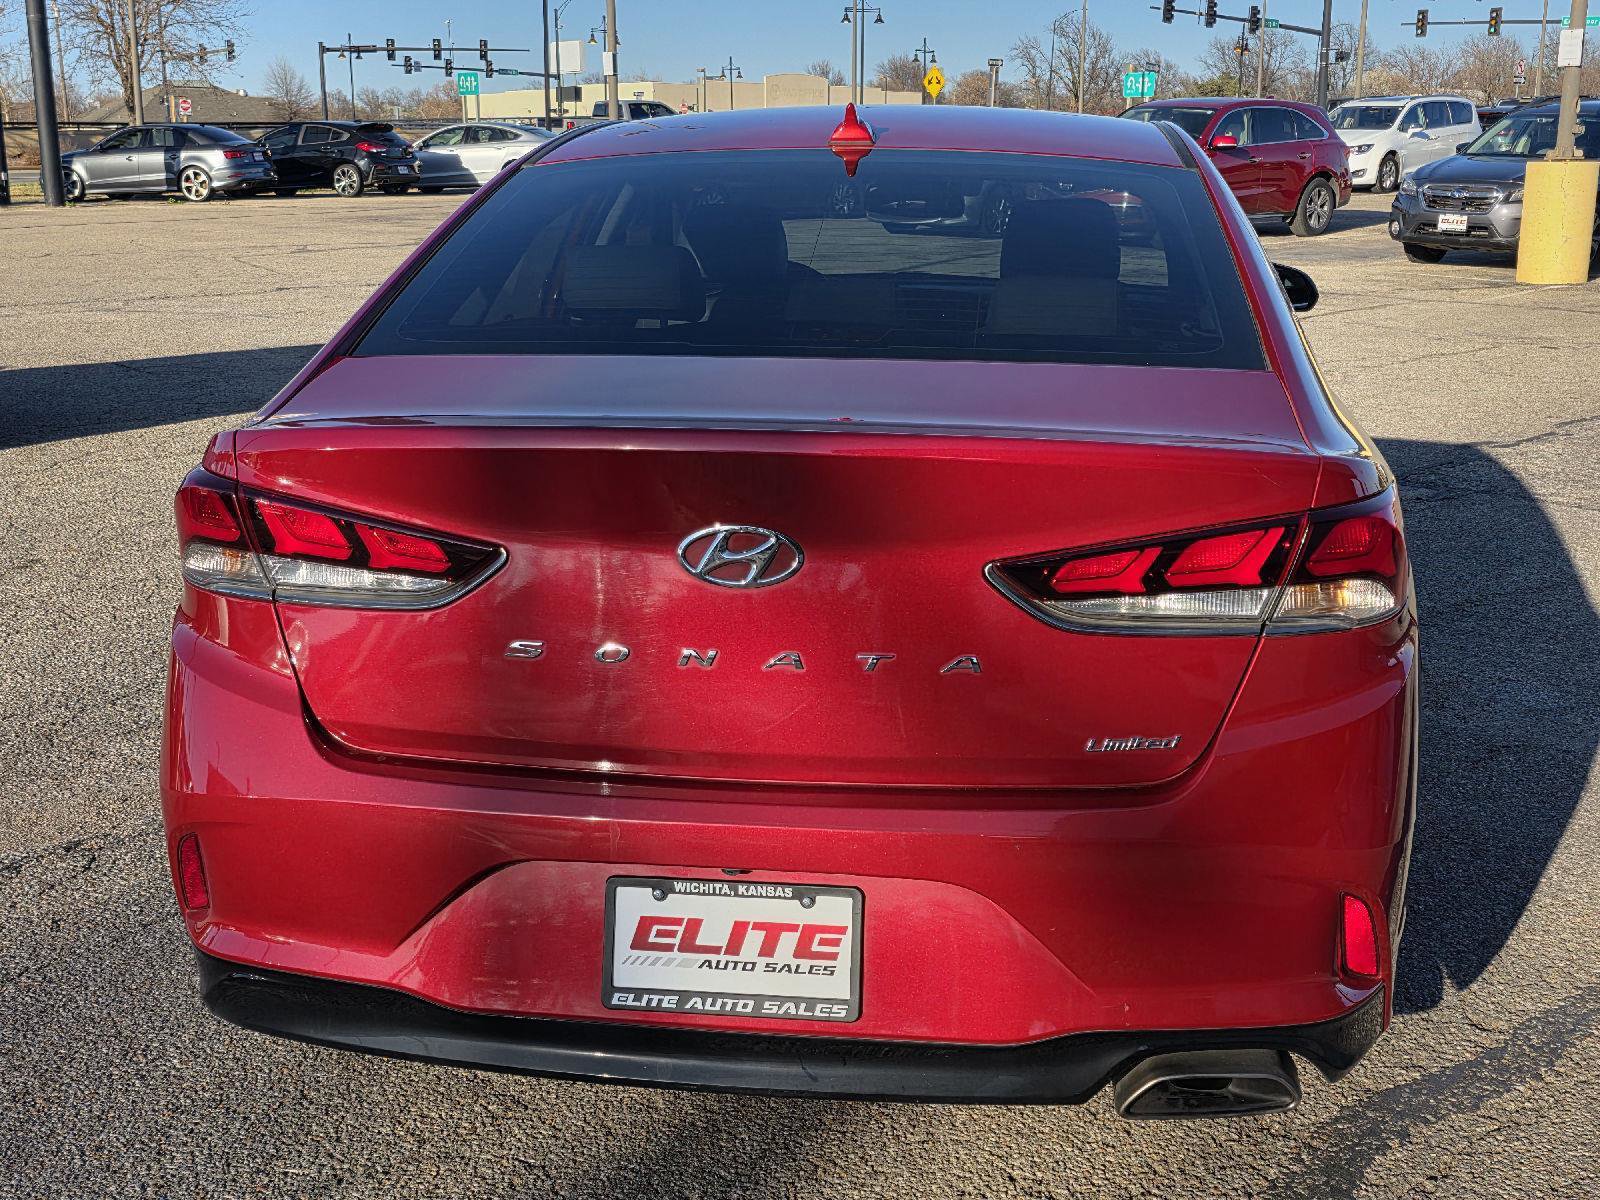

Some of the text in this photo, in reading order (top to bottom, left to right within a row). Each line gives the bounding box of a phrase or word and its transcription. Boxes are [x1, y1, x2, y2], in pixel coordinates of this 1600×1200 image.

[504, 639, 983, 674] SONATA
[1086, 735, 1181, 752] Limited
[673, 881, 793, 898] WICHITA, KANSAS
[629, 915, 849, 961] ELITE
[698, 958, 837, 977] AUTO SALES
[611, 992, 849, 1018] ELITE AUTO SALES
